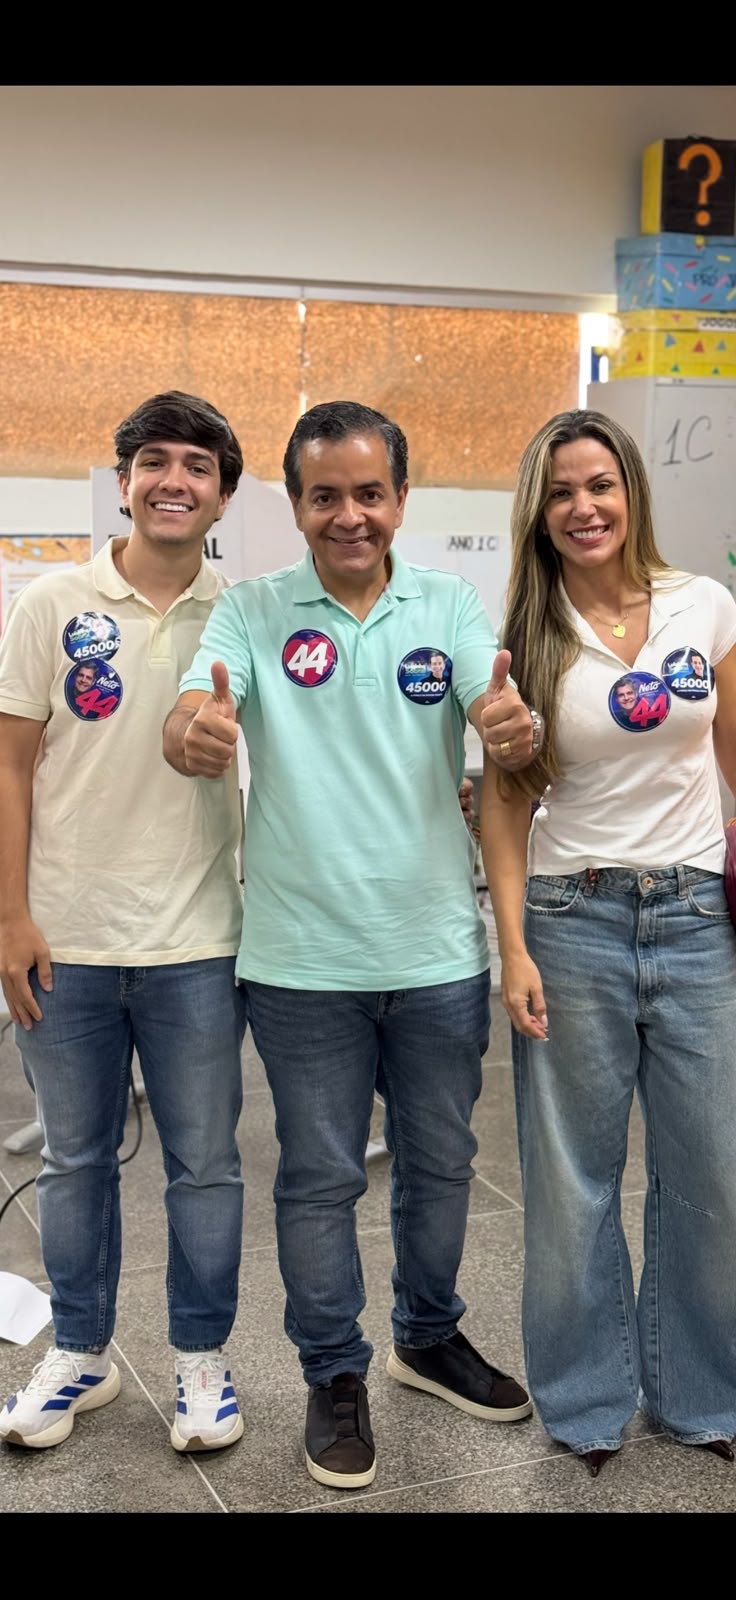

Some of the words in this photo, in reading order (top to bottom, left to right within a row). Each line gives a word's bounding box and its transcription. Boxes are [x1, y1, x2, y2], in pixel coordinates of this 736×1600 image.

[73, 640, 115, 659] 45000
[287, 641, 328, 678] 44
[96, 677, 120, 690] Neto
[405, 681, 446, 692] 45000
[639, 681, 660, 693] Neto
[671, 677, 710, 690] 45000
[75, 689, 119, 718] 44
[629, 693, 667, 727] 44
